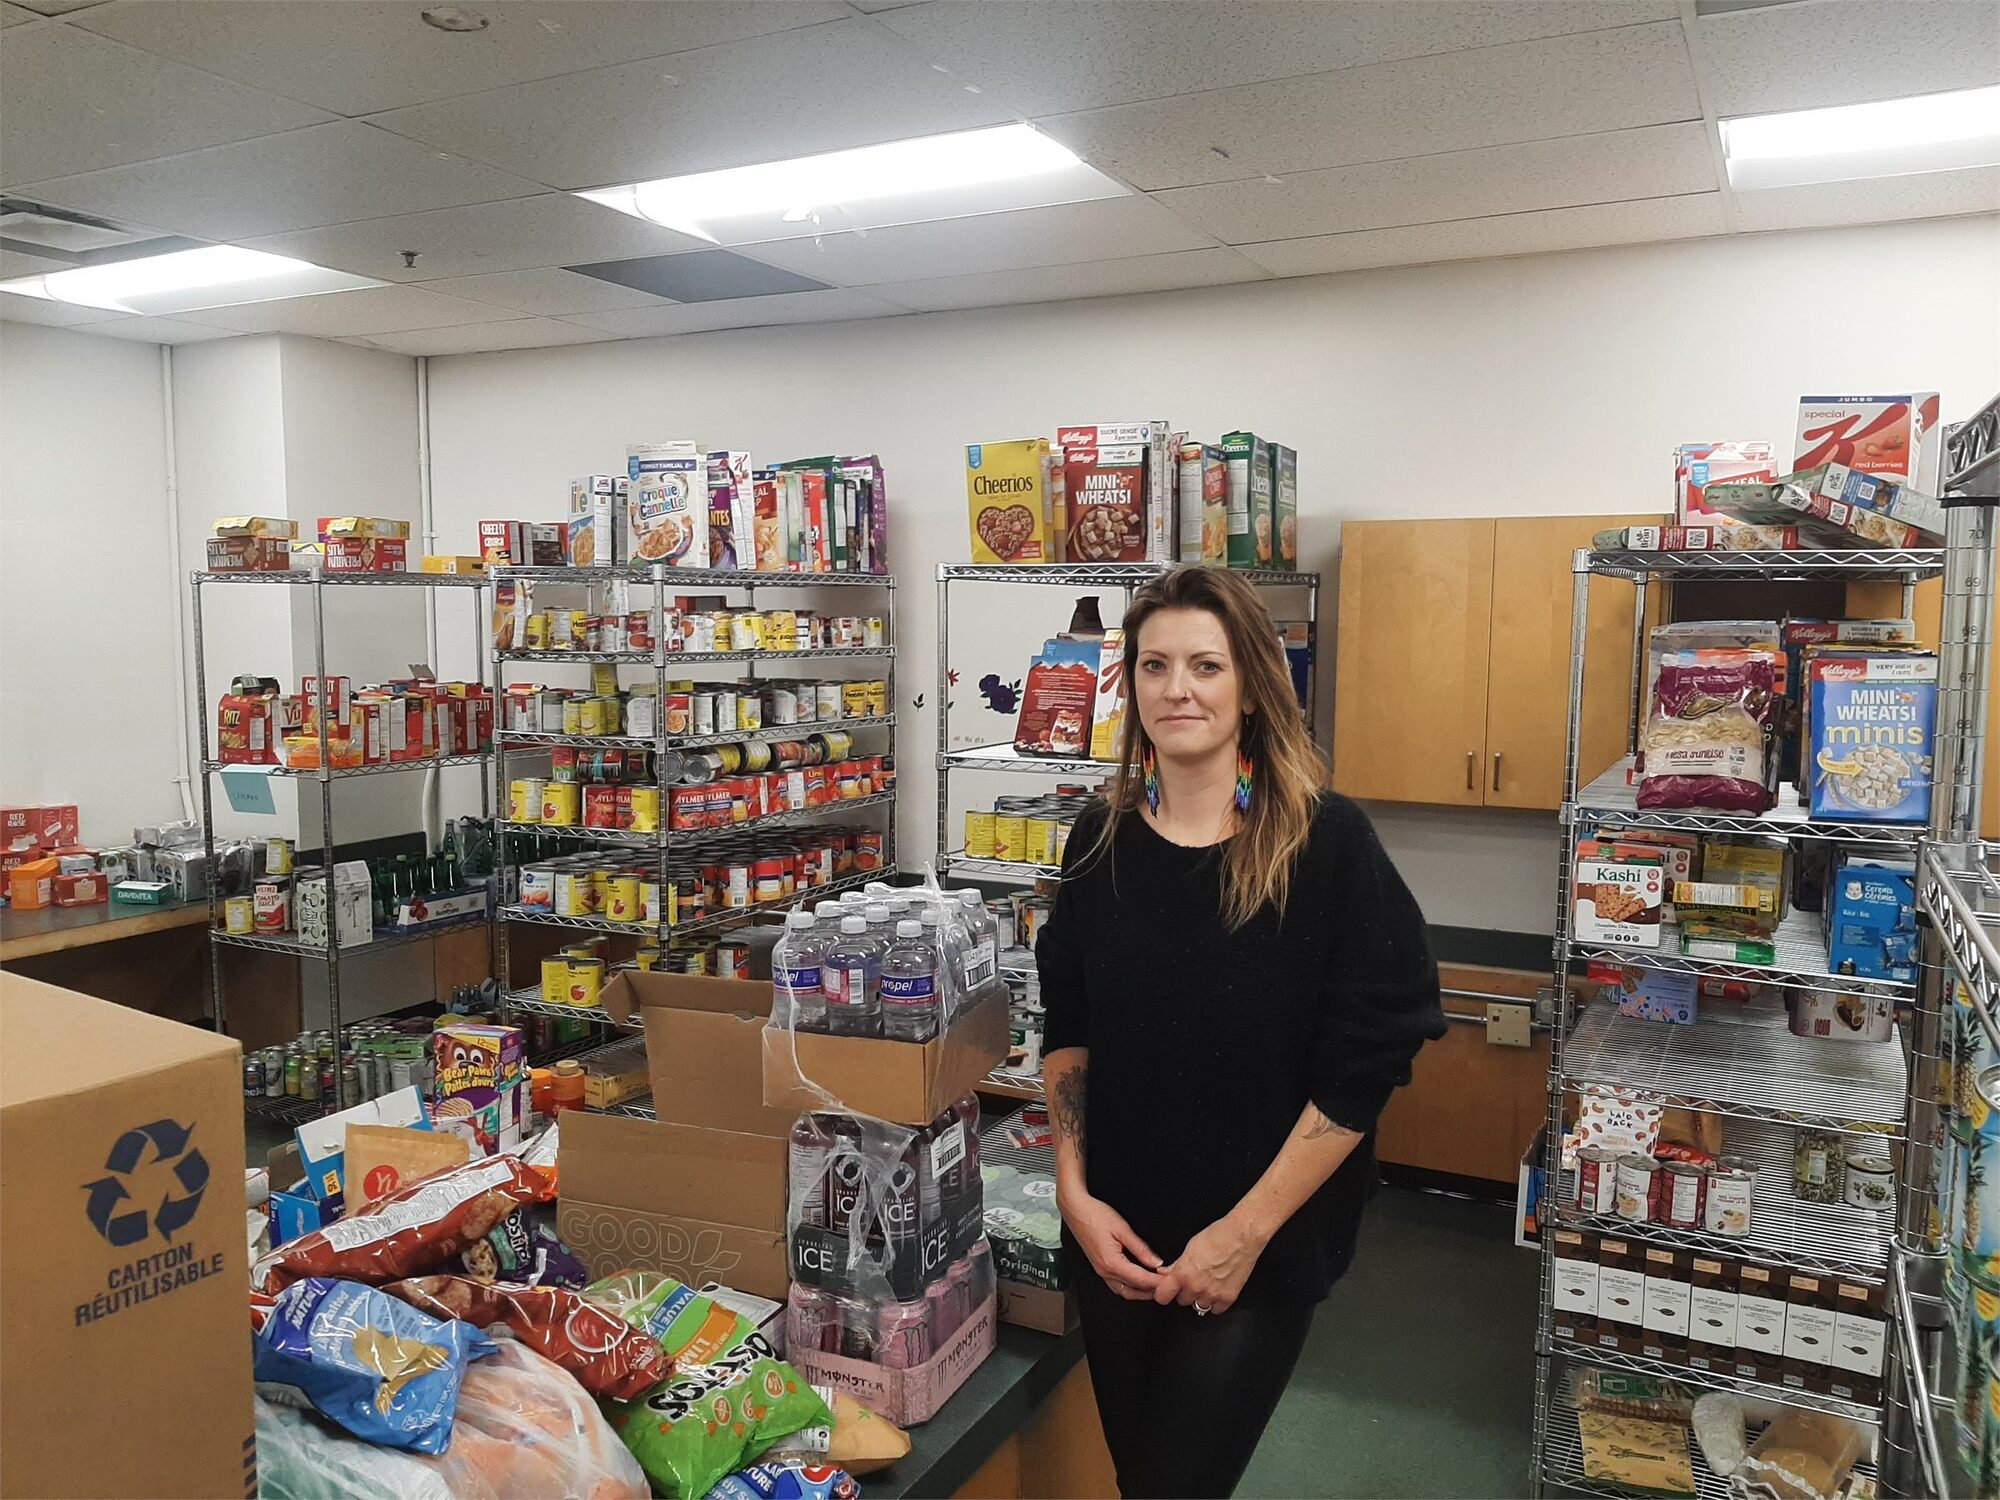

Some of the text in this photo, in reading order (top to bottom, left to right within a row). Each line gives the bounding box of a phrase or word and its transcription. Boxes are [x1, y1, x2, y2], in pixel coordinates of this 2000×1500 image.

[1804, 409, 1846, 421] special
[1855, 461, 1904, 469] red berries
[974, 473, 1033, 496] Cheerios
[639, 486, 679, 503] Croque
[1076, 490, 1131, 505] WHEATS!
[1965, 577, 1981, 588] 69
[224, 709, 241, 724] RITZ
[1836, 705, 1917, 722] WHEATS!
[1826, 722, 1924, 745] minis
[9, 813, 25, 821] RED
[4, 857, 21, 866] RED
[1596, 867, 1641, 883] Kashi
[256, 894, 280, 902] TOMATO
[881, 978, 913, 993] propel
[444, 1065, 493, 1083] Bear Paws
[1607, 1119, 1633, 1129] BACK
[1610, 1110, 1633, 1121] LAID
[883, 1202, 917, 1222] ICE
[561, 1208, 691, 1262] GOOD
[798, 1244, 834, 1273] ICE
[921, 1229, 948, 1276] ICE
[107, 1242, 193, 1289] CARTON
[999, 1257, 1050, 1280] Original
[74, 1252, 225, 1328] RÉUTILISABLE
[661, 1292, 695, 1327] VALUE
